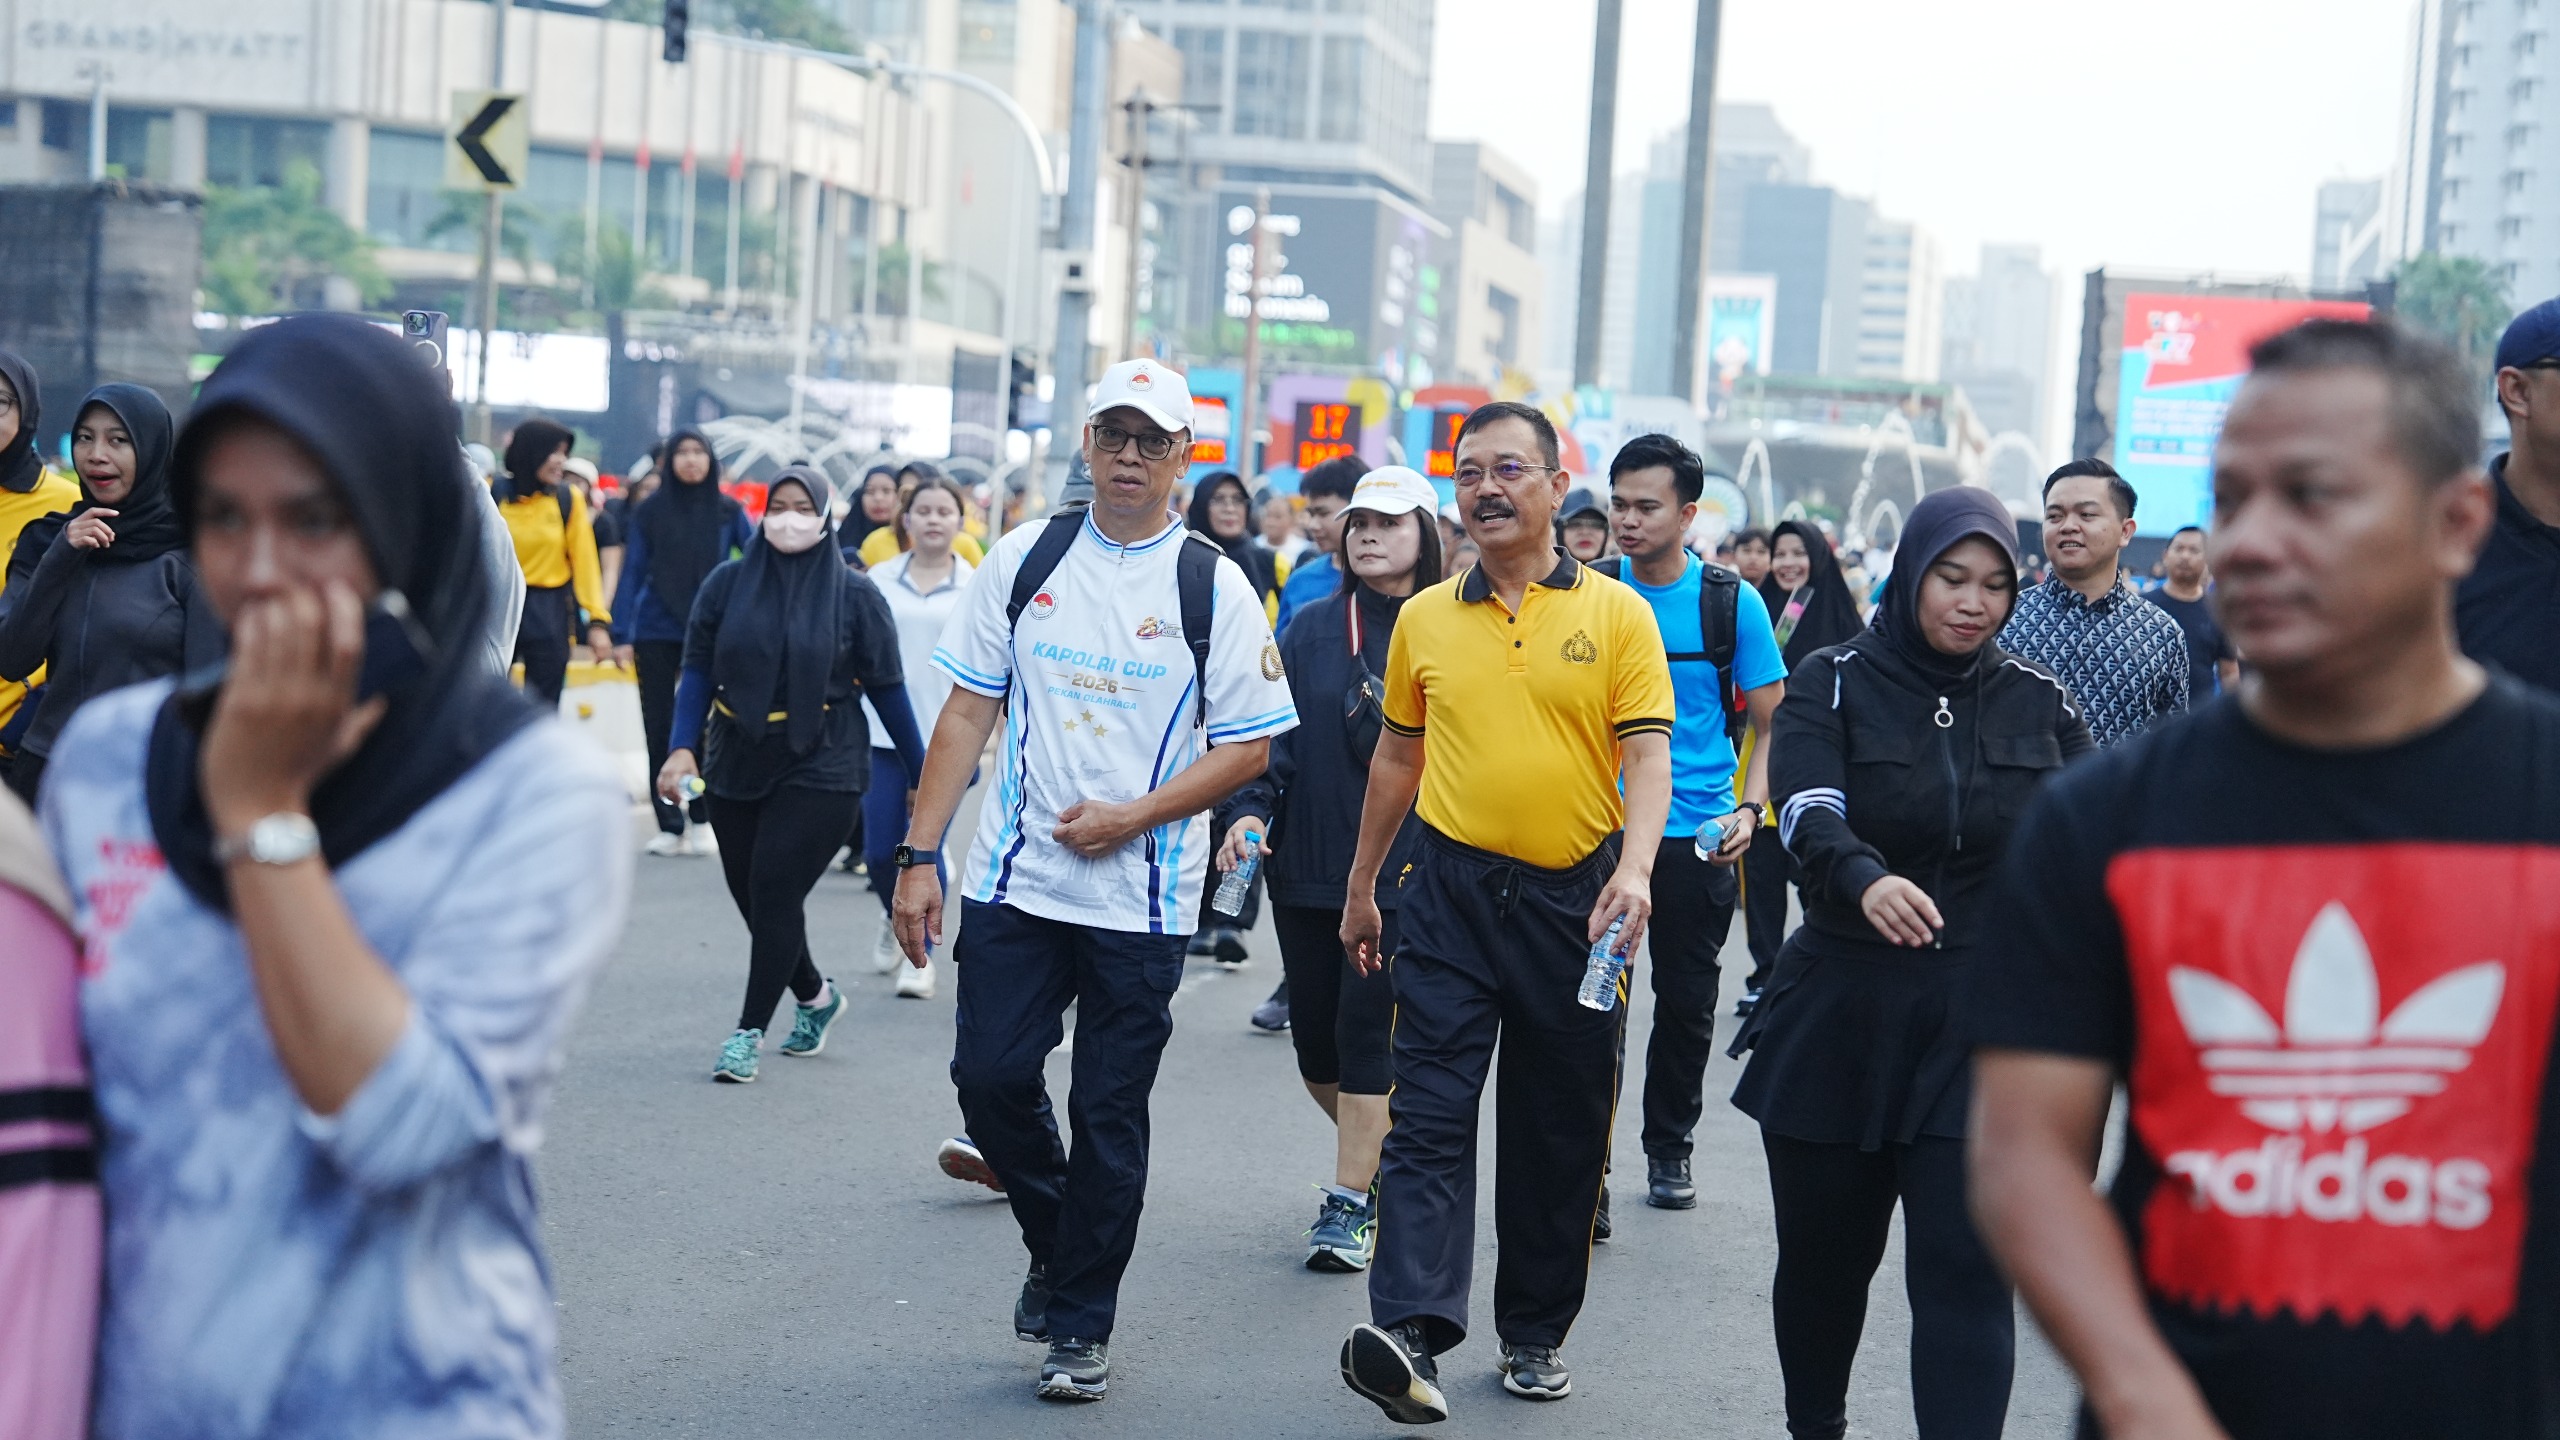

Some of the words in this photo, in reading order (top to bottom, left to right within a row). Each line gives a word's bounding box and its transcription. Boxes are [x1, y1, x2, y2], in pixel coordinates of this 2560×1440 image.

[26, 20, 155, 55] GRAND
[176, 28, 301, 60] HYATT
[1310, 404, 1350, 440] 17
[1032, 641, 1117, 673] KAPOLRI
[1122, 660, 1167, 680] CUP
[1047, 686, 1081, 700] PEKAN
[1083, 694, 1137, 710] OLAHRAGA
[1071, 672, 1119, 694] 2026
